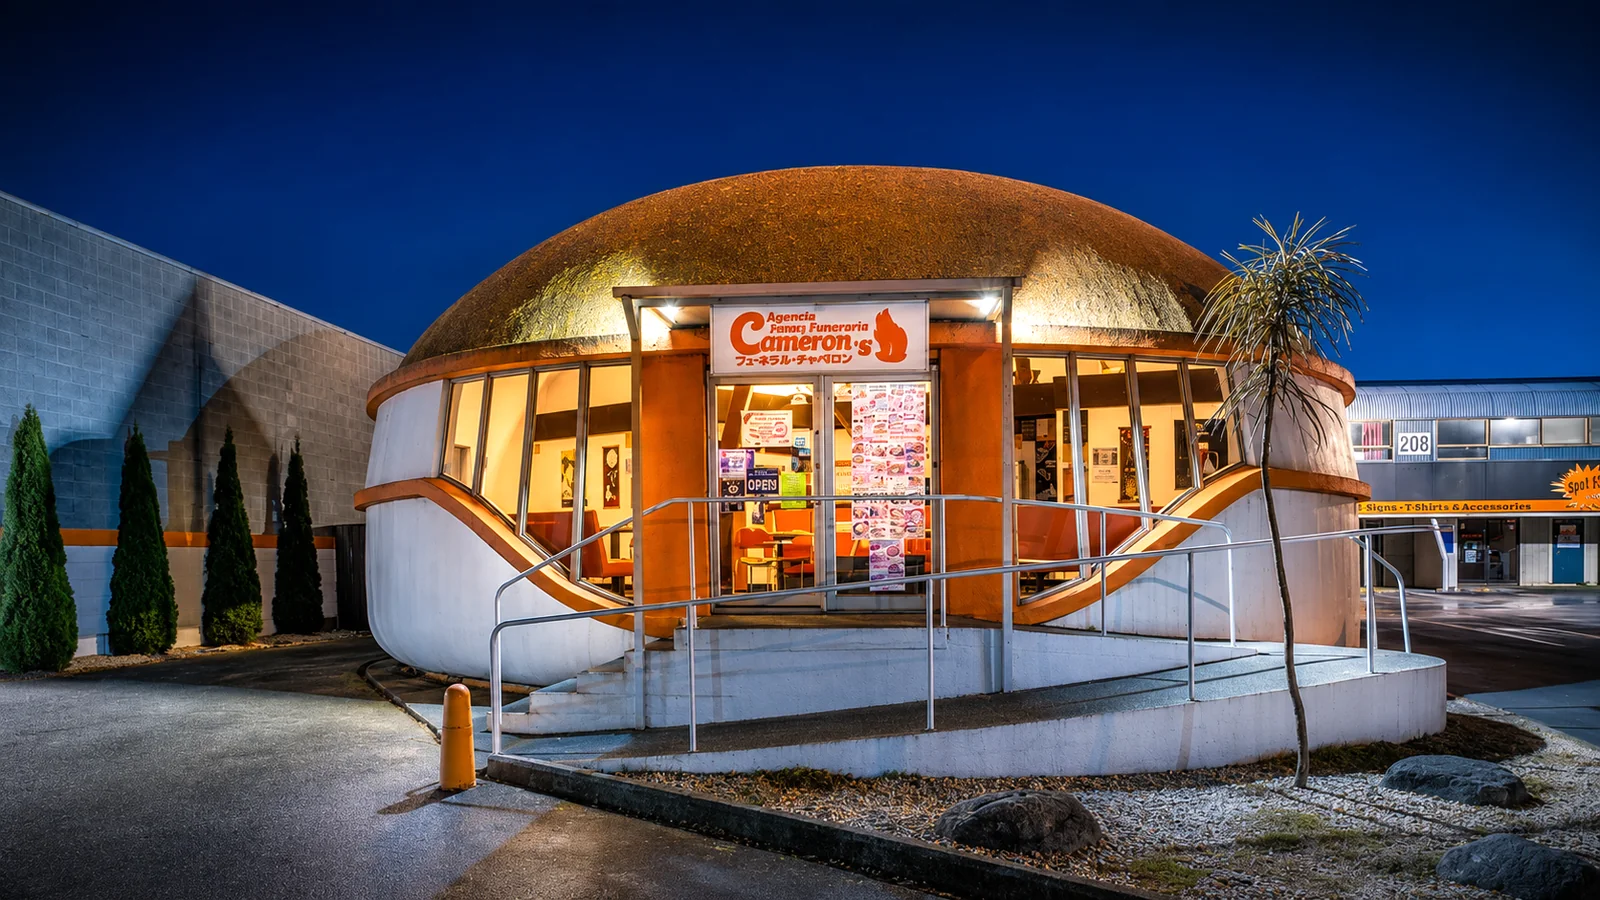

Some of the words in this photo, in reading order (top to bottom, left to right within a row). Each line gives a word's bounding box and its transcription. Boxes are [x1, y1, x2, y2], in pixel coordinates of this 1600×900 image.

[767, 312, 816, 323] Agencia
[809, 321, 869, 333] Funeraria
[1400, 435, 1429, 452] 208
[748, 479, 777, 491] OPEN
[1366, 503, 1397, 512] Signs
[1452, 503, 1460, 511] &
[1461, 502, 1532, 511] Accessories
